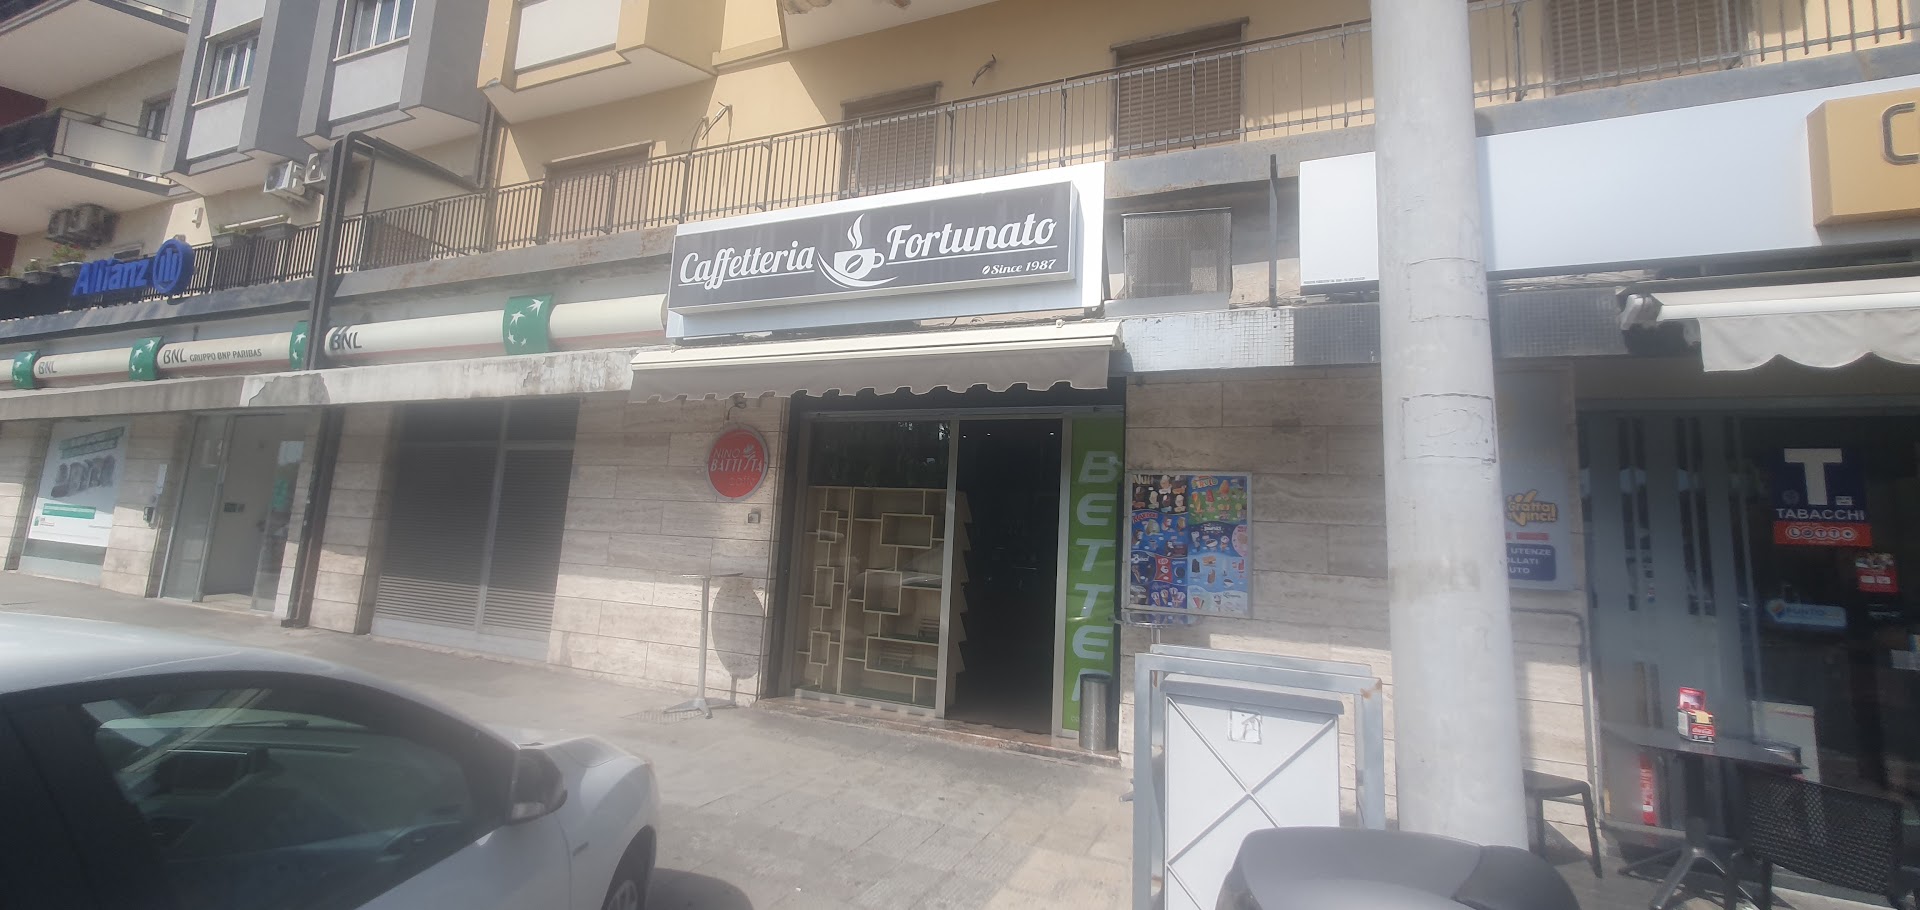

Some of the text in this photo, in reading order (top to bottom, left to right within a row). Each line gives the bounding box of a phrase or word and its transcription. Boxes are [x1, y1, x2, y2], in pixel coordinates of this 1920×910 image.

[678, 212, 1058, 290] Caffetteria Fortunato
[990, 258, 1057, 275] Since 1987
[72, 258, 151, 296] Allianz
[329, 332, 362, 350] BNL
[163, 348, 262, 364] BNL GRUPPO BNP PARIBAS
[38, 361, 57, 374] BNL
[713, 448, 740, 458] NINO
[710, 458, 763, 472] BATTISTA
[1784, 448, 1842, 506] T
[1775, 508, 1865, 520] TABACCHI
[1511, 547, 1552, 556] UTENZE
